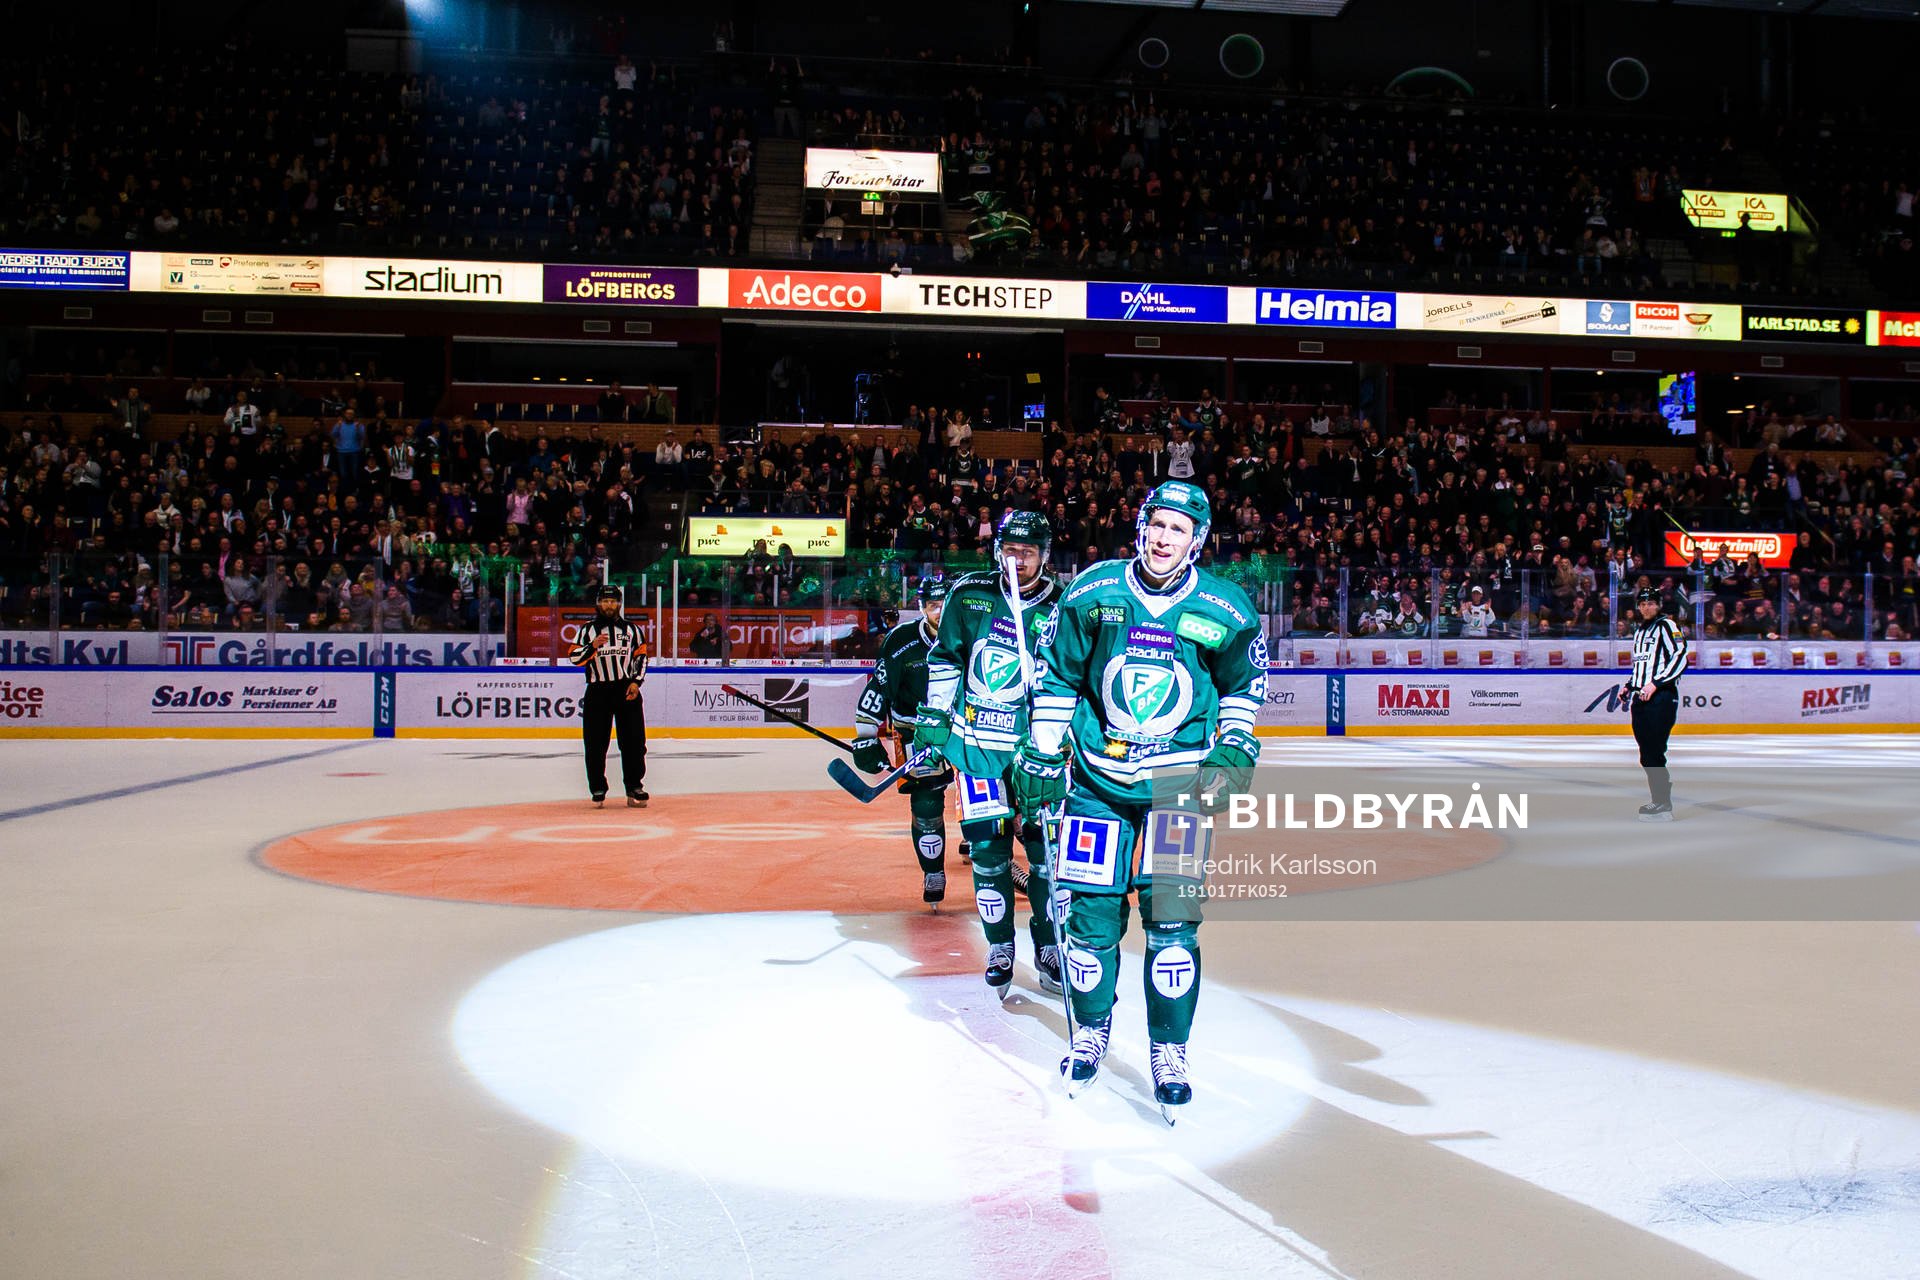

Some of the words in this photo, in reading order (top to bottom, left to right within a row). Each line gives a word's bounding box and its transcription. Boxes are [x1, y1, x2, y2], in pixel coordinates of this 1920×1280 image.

[1695, 194, 1717, 207] ICA
[1745, 197, 1766, 210] ICA
[44, 255, 80, 267] RADIO
[82, 256, 126, 268] SUPPLY
[365, 265, 502, 294] stadium
[590, 271, 651, 280] KAFFEROSTERIET
[566, 278, 676, 300] LÖFBERGS
[743, 275, 867, 308] Adecco
[919, 283, 1052, 310] TECHSTEP
[1120, 291, 1171, 305] DAHL
[1260, 292, 1392, 322] Helmia
[1425, 301, 1473, 318] JORDELLS
[1637, 307, 1677, 317] RICOH
[1748, 316, 1841, 333] KARLSTAD.SE
[691, 448, 707, 459] Lee
[697, 537, 721, 548] pwc
[807, 538, 830, 549] pwc
[1067, 577, 1120, 602] MOELVEN
[1198, 591, 1247, 625] MOELVEN
[993, 622, 1018, 635] LÖFBER
[1130, 630, 1173, 644] LÖFBERGS
[1183, 620, 1222, 642] coop
[1125, 645, 1174, 661] stadium
[0, 681, 44, 702] ice
[151, 685, 234, 707] Salos
[242, 686, 303, 696] Markiser
[305, 686, 319, 696] &
[1136, 687, 1159, 712] BK
[1266, 690, 1295, 705] sen
[1378, 684, 1450, 709] MAXI
[1470, 689, 1519, 698] Välkommen
[1801, 684, 1871, 709] RIXFM
[241, 699, 314, 709] Persienner
[316, 699, 337, 709] AB
[379, 676, 390, 725] CCM
[861, 689, 884, 714] 65
[1332, 678, 1340, 723] CCM
[1683, 695, 1723, 708] ROC
[976, 711, 1017, 728] ENERGI
[1820, 707, 1840, 715] MUSIK
